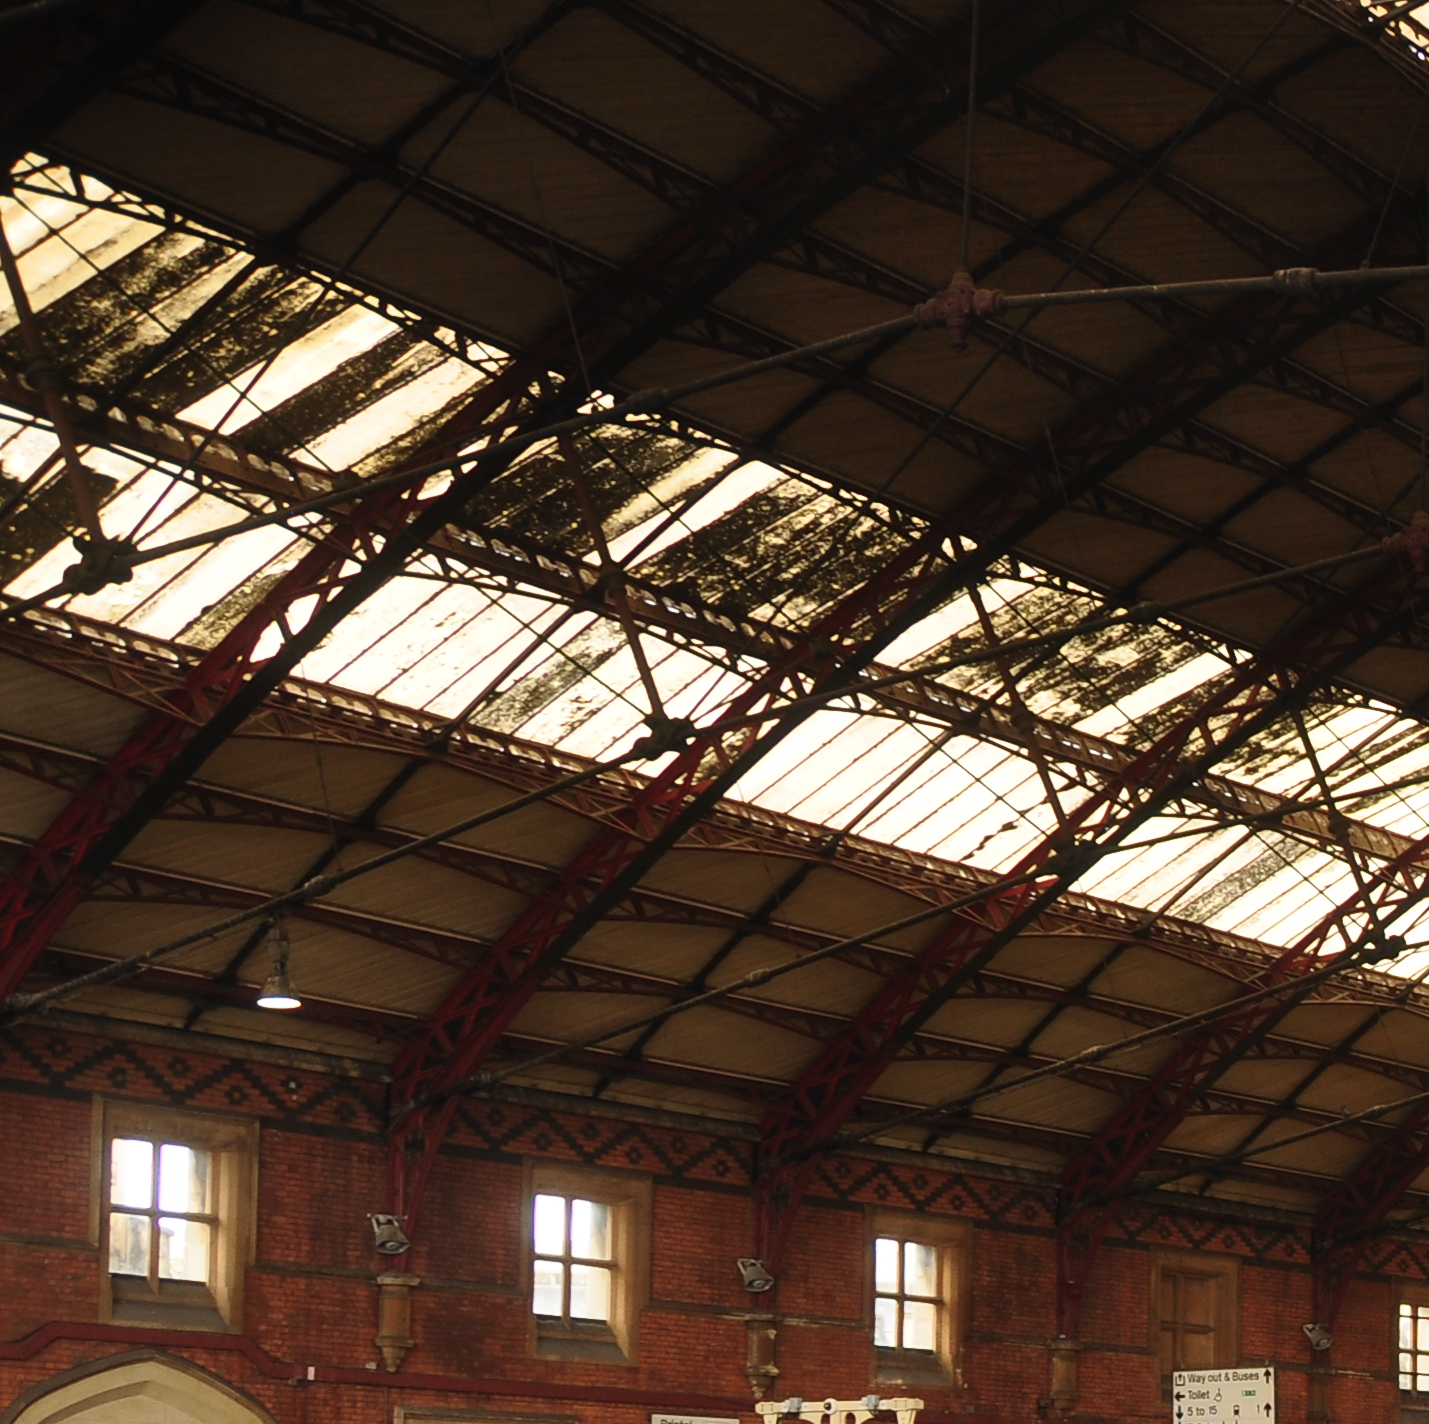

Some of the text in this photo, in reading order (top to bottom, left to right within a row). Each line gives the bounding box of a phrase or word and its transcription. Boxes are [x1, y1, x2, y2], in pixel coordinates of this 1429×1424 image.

[1188, 1371, 1259, 1384] Way out & Buses
[1188, 1390, 1210, 1400] Toilet
[1187, 1406, 1193, 1416] 5
[1196, 1407, 1205, 1416] to
[1209, 1405, 1217, 1415] 15
